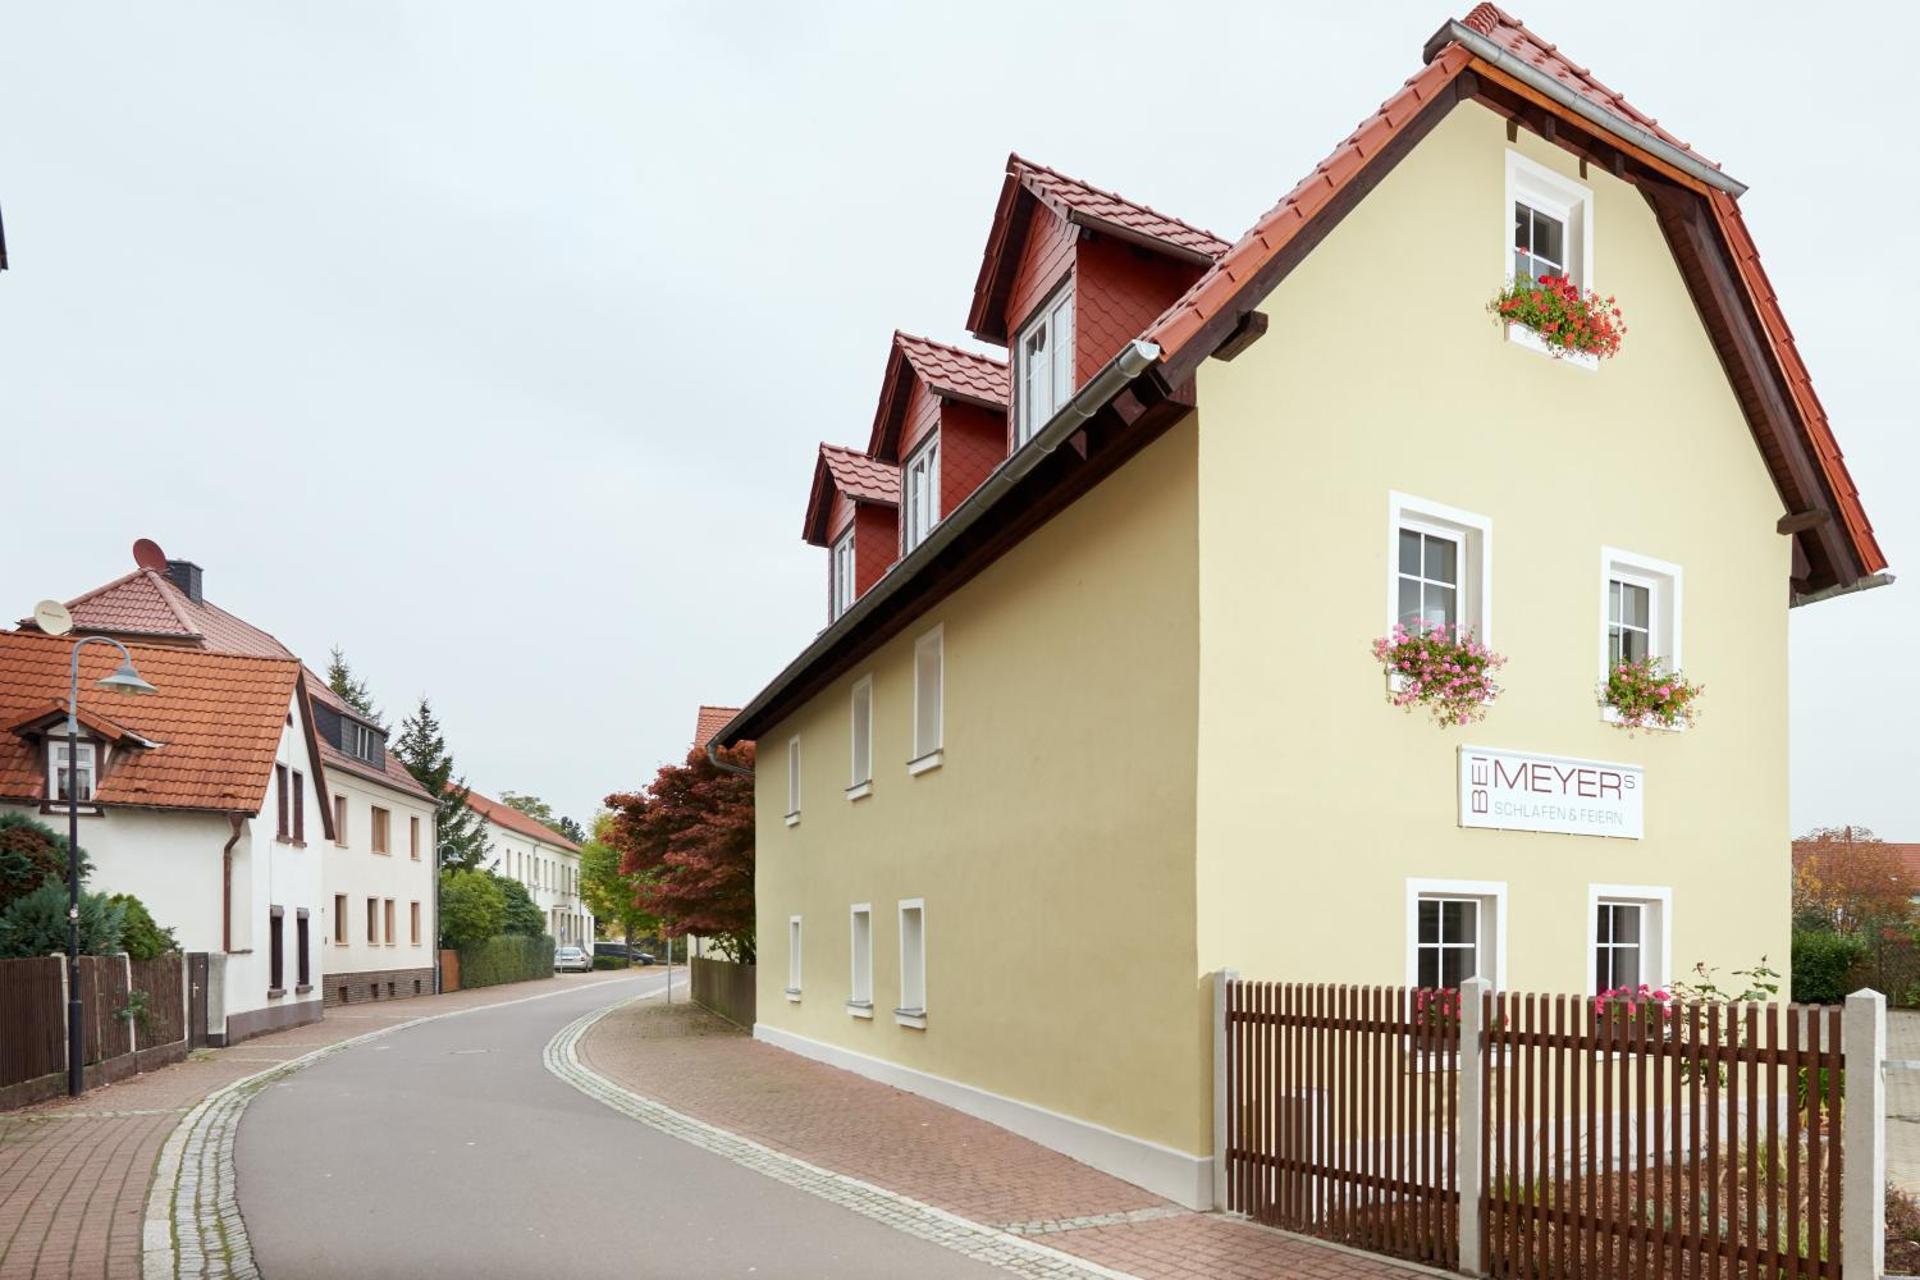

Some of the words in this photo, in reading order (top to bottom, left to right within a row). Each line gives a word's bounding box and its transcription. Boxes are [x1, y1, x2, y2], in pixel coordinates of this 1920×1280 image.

[1472, 757, 1488, 813] BEI
[1494, 801, 1566, 820] SCHLAFEN
[1569, 808, 1577, 821] &
[1580, 808, 1623, 825] FEIERN
